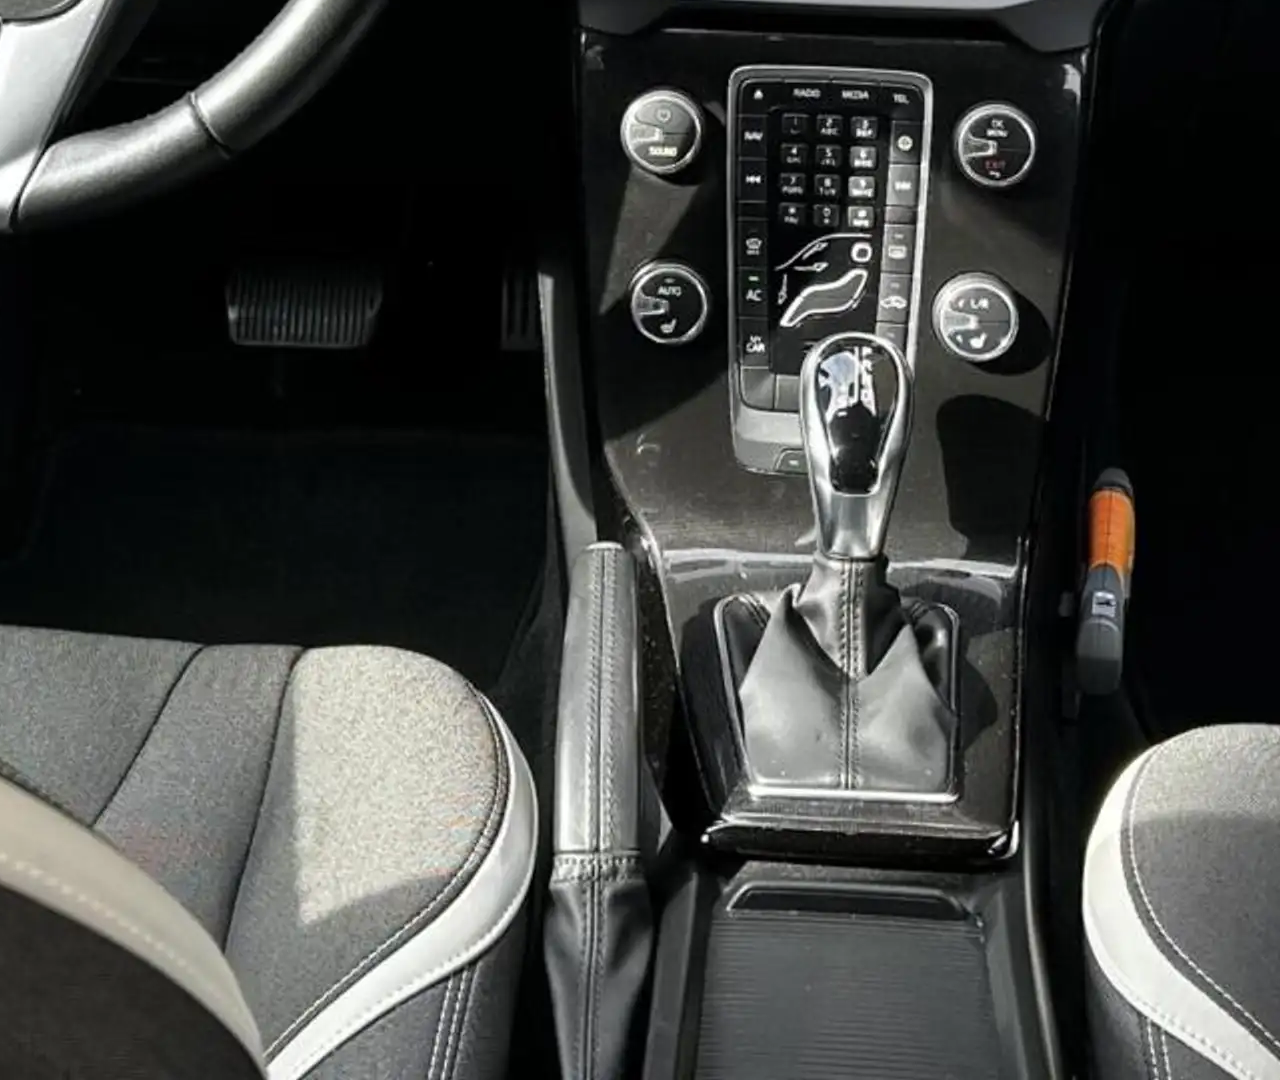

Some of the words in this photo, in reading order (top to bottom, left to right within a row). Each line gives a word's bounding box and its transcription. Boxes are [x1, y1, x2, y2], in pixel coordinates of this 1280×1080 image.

[793, 88, 821, 98] RADIO
[842, 90, 869, 99] MEDIA
[893, 93, 910, 104] TEL
[744, 131, 763, 141] NAV
[658, 286, 682, 297] AUTO
[746, 290, 762, 302] AC
[746, 343, 765, 352] CAR
